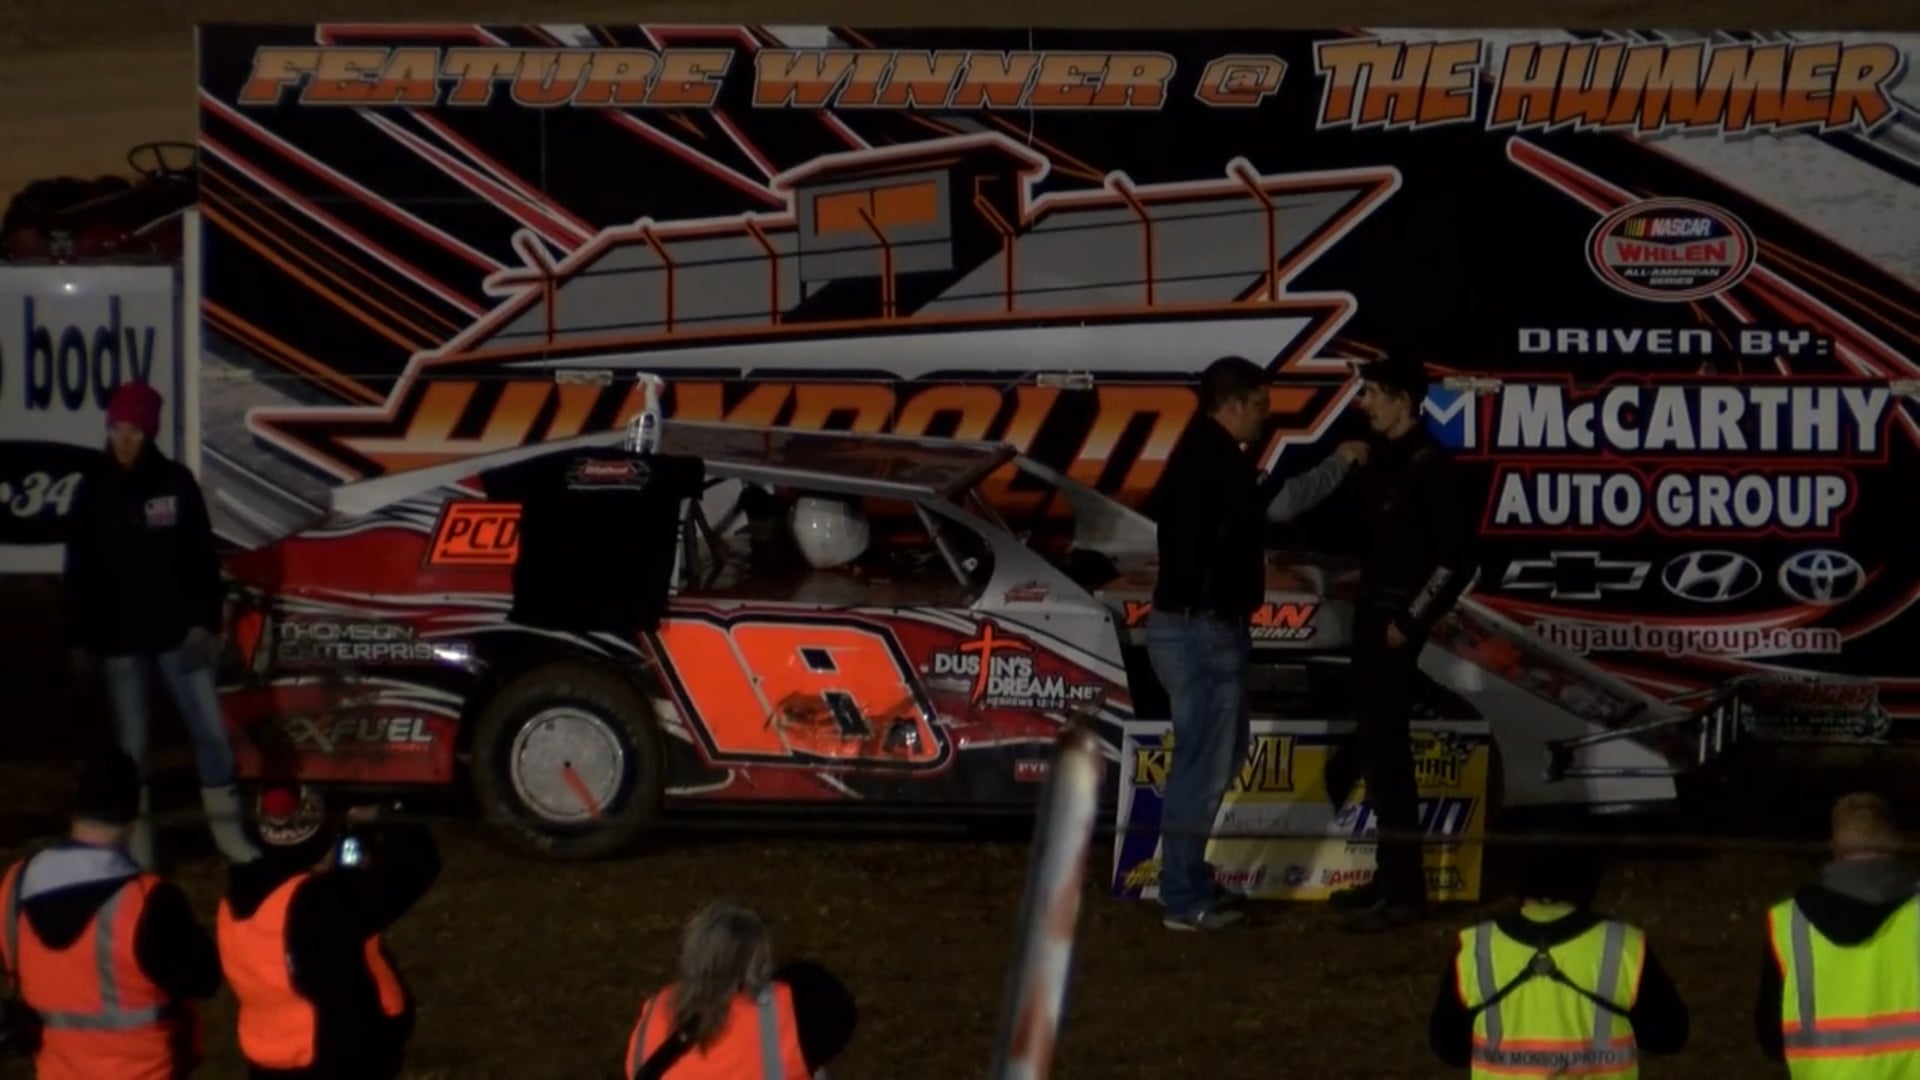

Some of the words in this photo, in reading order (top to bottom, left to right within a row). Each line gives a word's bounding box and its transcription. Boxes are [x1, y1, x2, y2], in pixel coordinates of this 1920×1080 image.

[238, 47, 734, 107] FEATURE
[751, 50, 1177, 109] WINNER
[1313, 38, 1482, 130] THE
[1486, 38, 1900, 135] HUMMER
[1651, 217, 1713, 237] NASCAR
[1617, 242, 1727, 262] WHELEN
[1518, 327, 1711, 355] DRIVEN
[1740, 330, 1829, 356] BY:
[1497, 382, 1891, 453] McCARTHY
[1494, 472, 1643, 525] AUTO
[1656, 474, 1848, 528] GROUP
[445, 517, 521, 550] PCD
[278, 624, 414, 641] THOMSON
